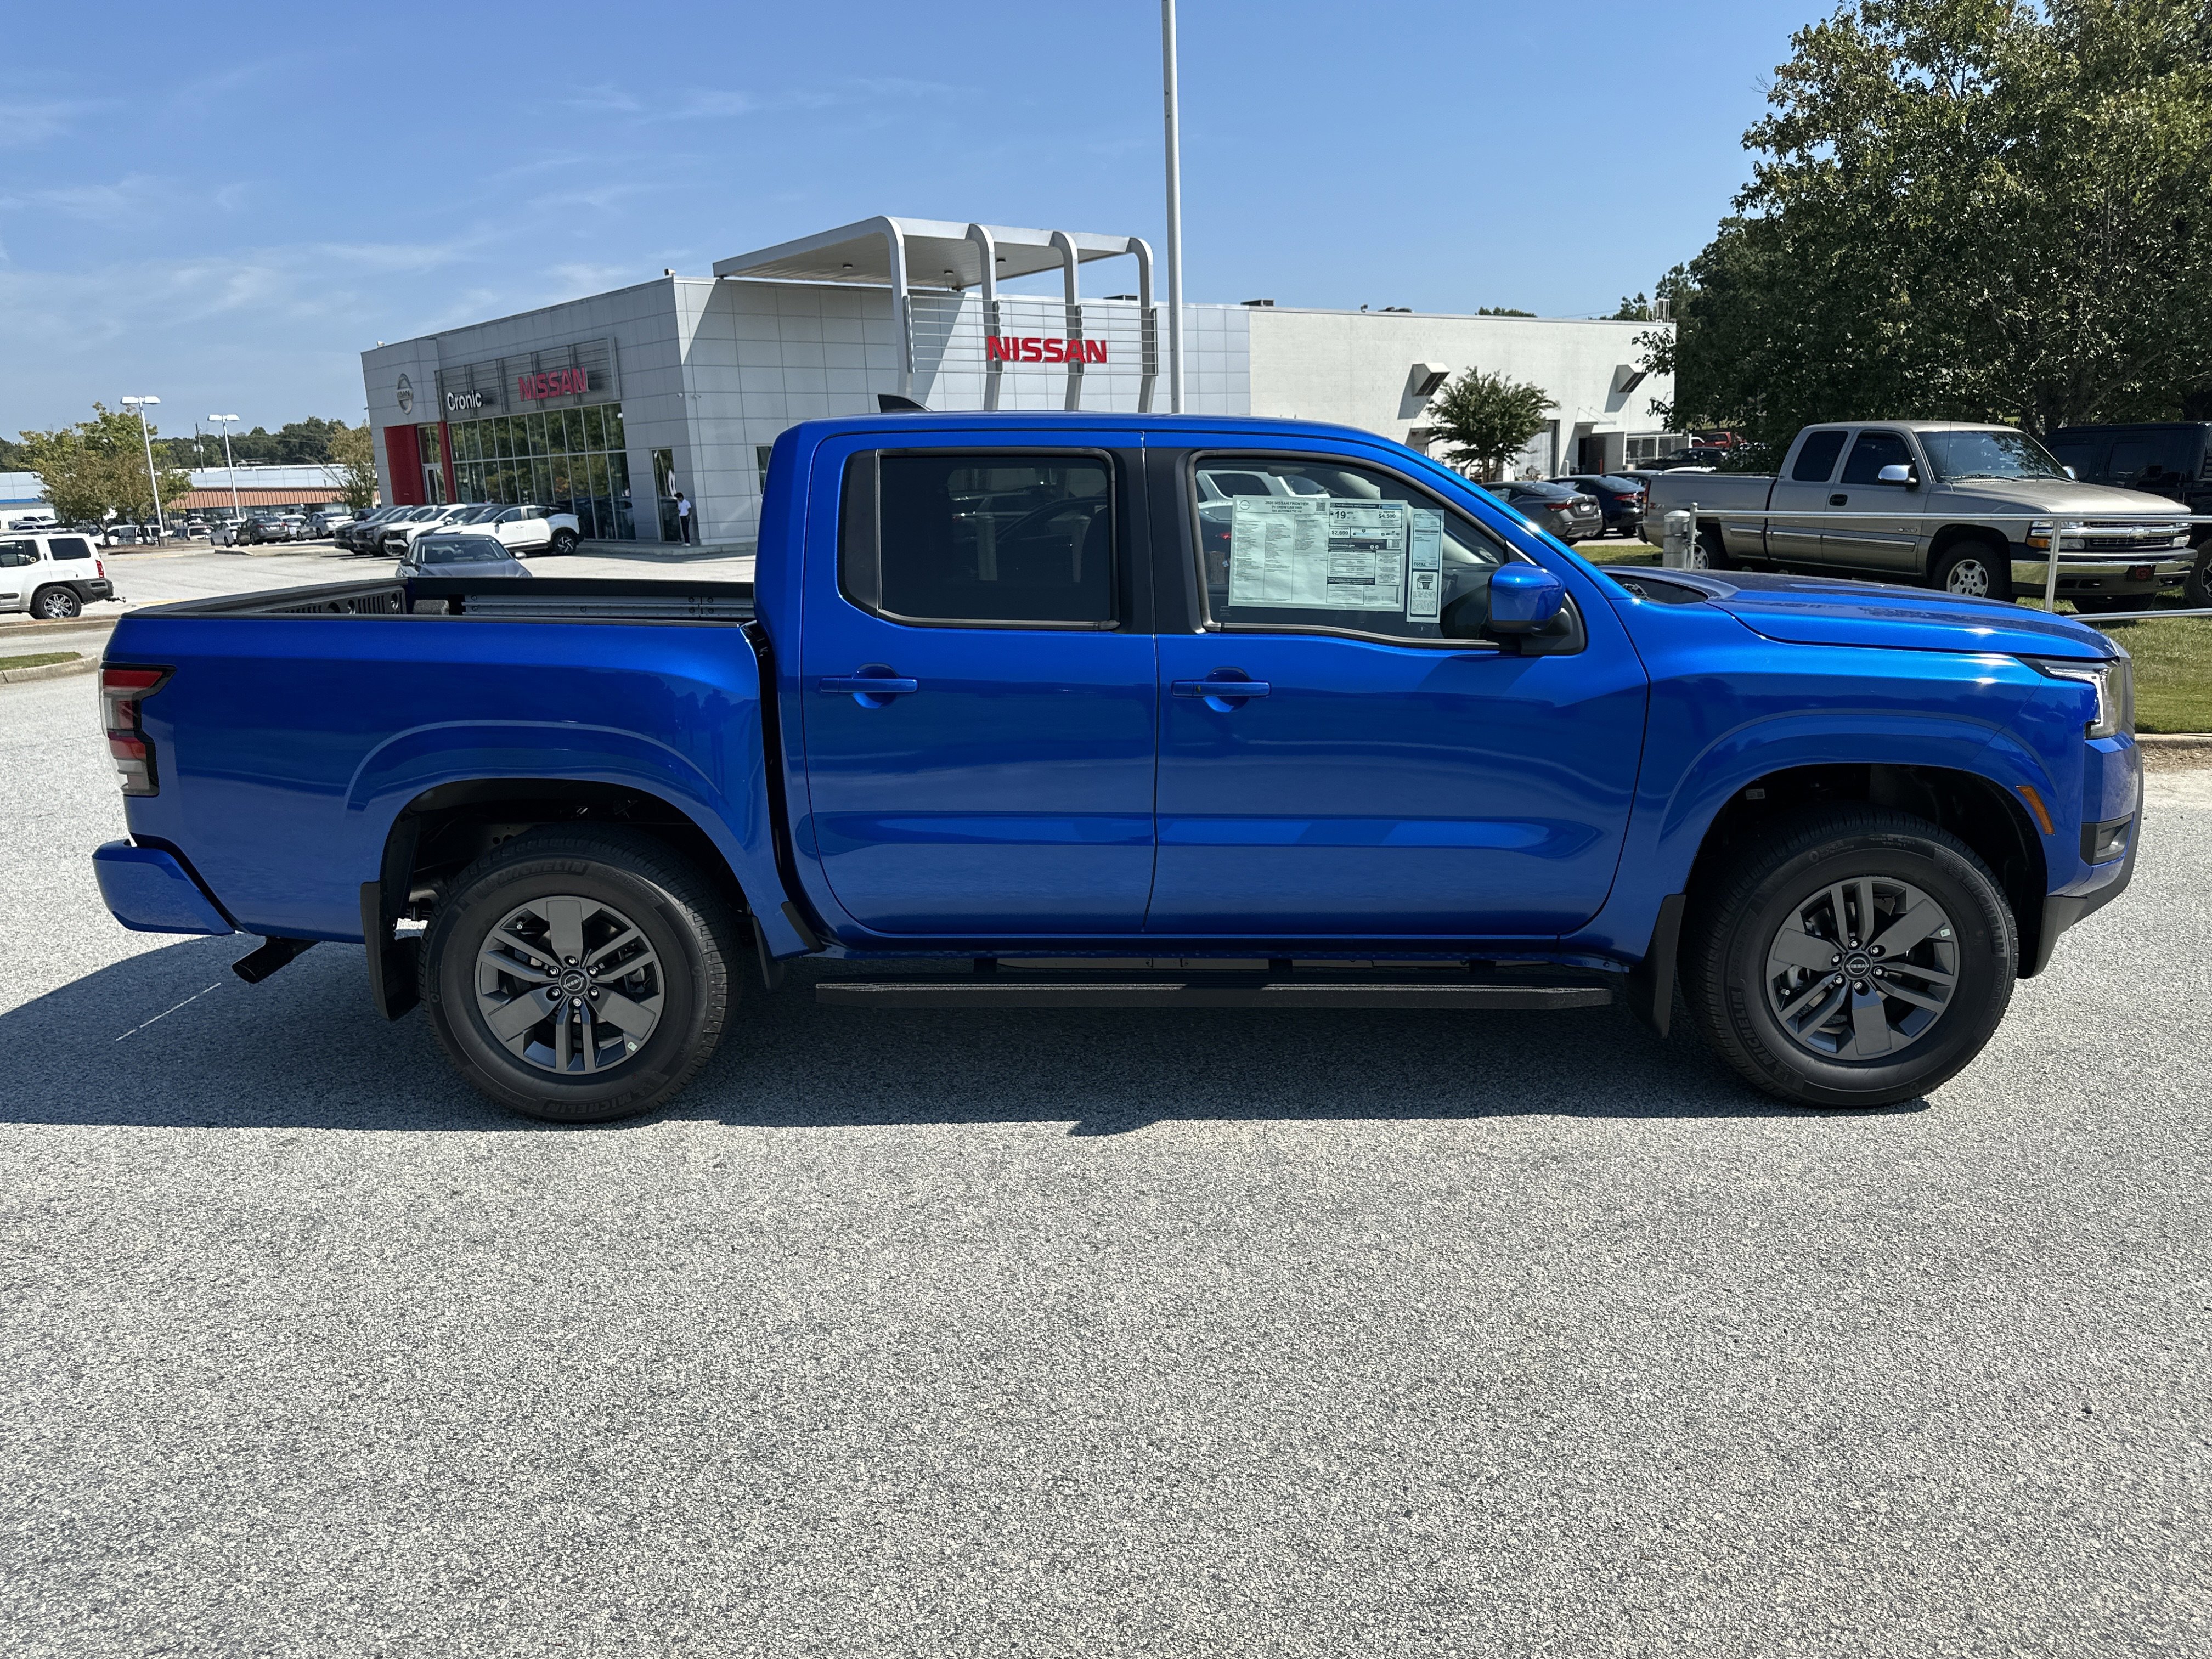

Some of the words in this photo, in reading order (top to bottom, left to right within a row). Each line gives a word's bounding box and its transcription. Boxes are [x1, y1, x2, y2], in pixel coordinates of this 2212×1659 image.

[988, 335, 1107, 363] NISSAN
[447, 390, 482, 411] Cronic
[518, 366, 588, 402] NISSAN
[1335, 511, 1346, 519] 19
[498, 860, 587, 884] MICHELIN
[1962, 876, 2004, 953] MICHELIN
[1730, 958, 1740, 977] 265
[1735, 940, 1745, 953] 65
[1731, 990, 1776, 1065] MICHELIN
[546, 1090, 634, 1114] MICHELIN
